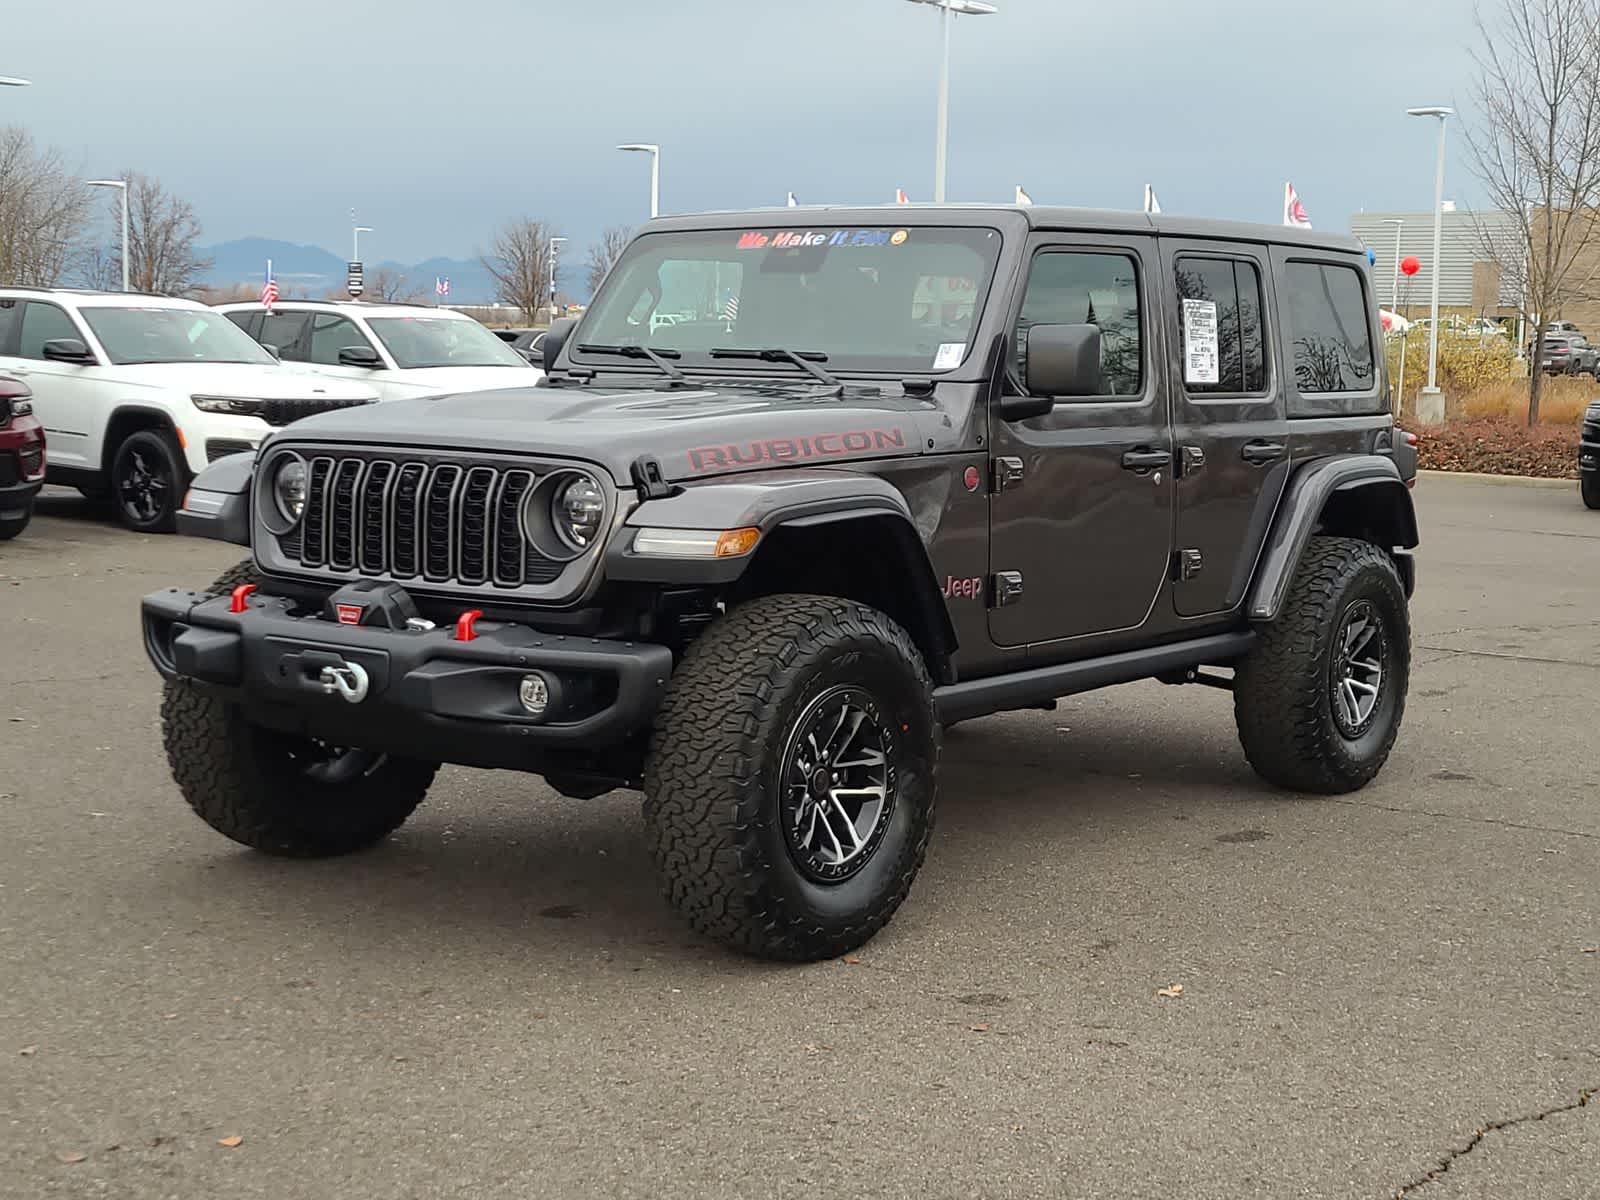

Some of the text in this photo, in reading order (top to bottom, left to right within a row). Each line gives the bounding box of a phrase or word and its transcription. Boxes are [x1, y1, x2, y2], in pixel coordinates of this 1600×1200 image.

[737, 232, 768, 248] We
[772, 231, 825, 247] Make
[829, 230, 849, 246] It
[688, 427, 906, 472] RUBICON
[941, 575, 982, 600] Jeep
